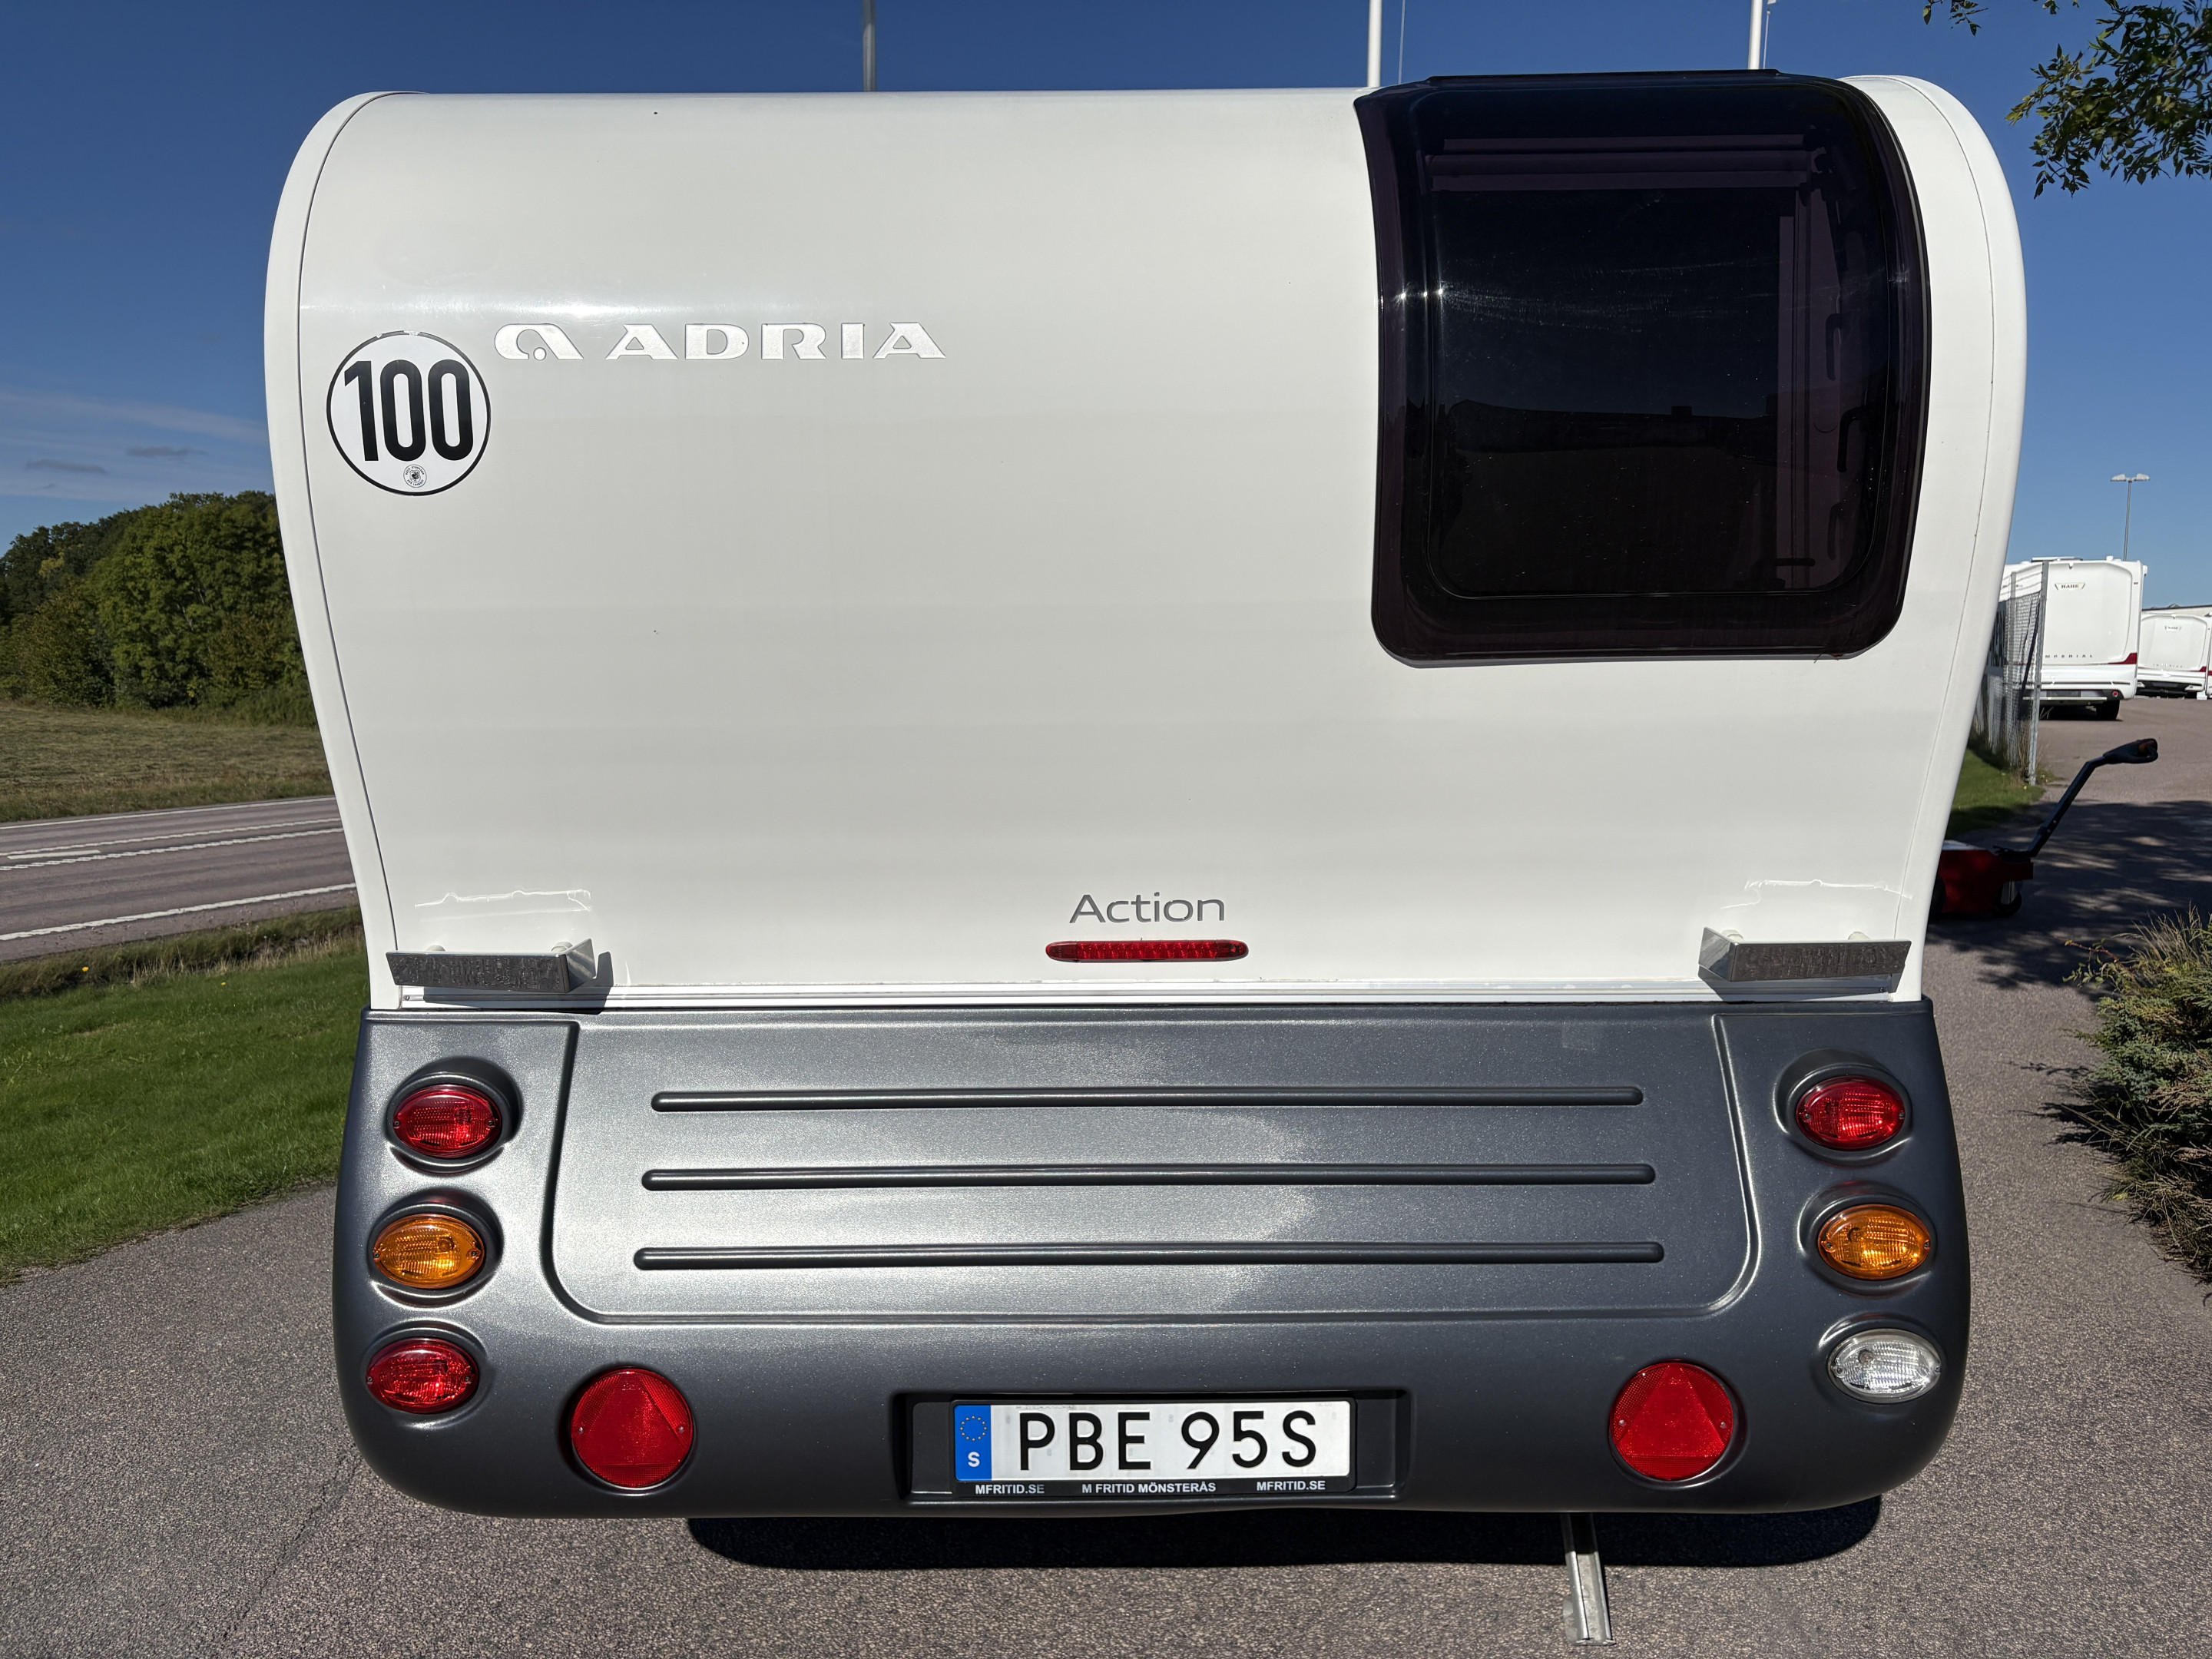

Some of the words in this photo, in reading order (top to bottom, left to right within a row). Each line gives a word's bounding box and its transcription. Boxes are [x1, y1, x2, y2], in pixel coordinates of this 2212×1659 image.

[604, 322, 947, 360] ADRIA
[344, 359, 474, 462] 100
[1068, 891, 1225, 924] Action
[1019, 1412, 1152, 1471] PBE
[1181, 1410, 1317, 1470] 95S
[967, 1452, 981, 1468] S
[975, 1484, 1045, 1495] MFRITID.SE
[1081, 1483, 1092, 1494] M
[1095, 1483, 1135, 1494] FRITID
[1138, 1481, 1217, 1494] MÖNSTERÅS
[1257, 1480, 1326, 1492] MFRITID.SE
